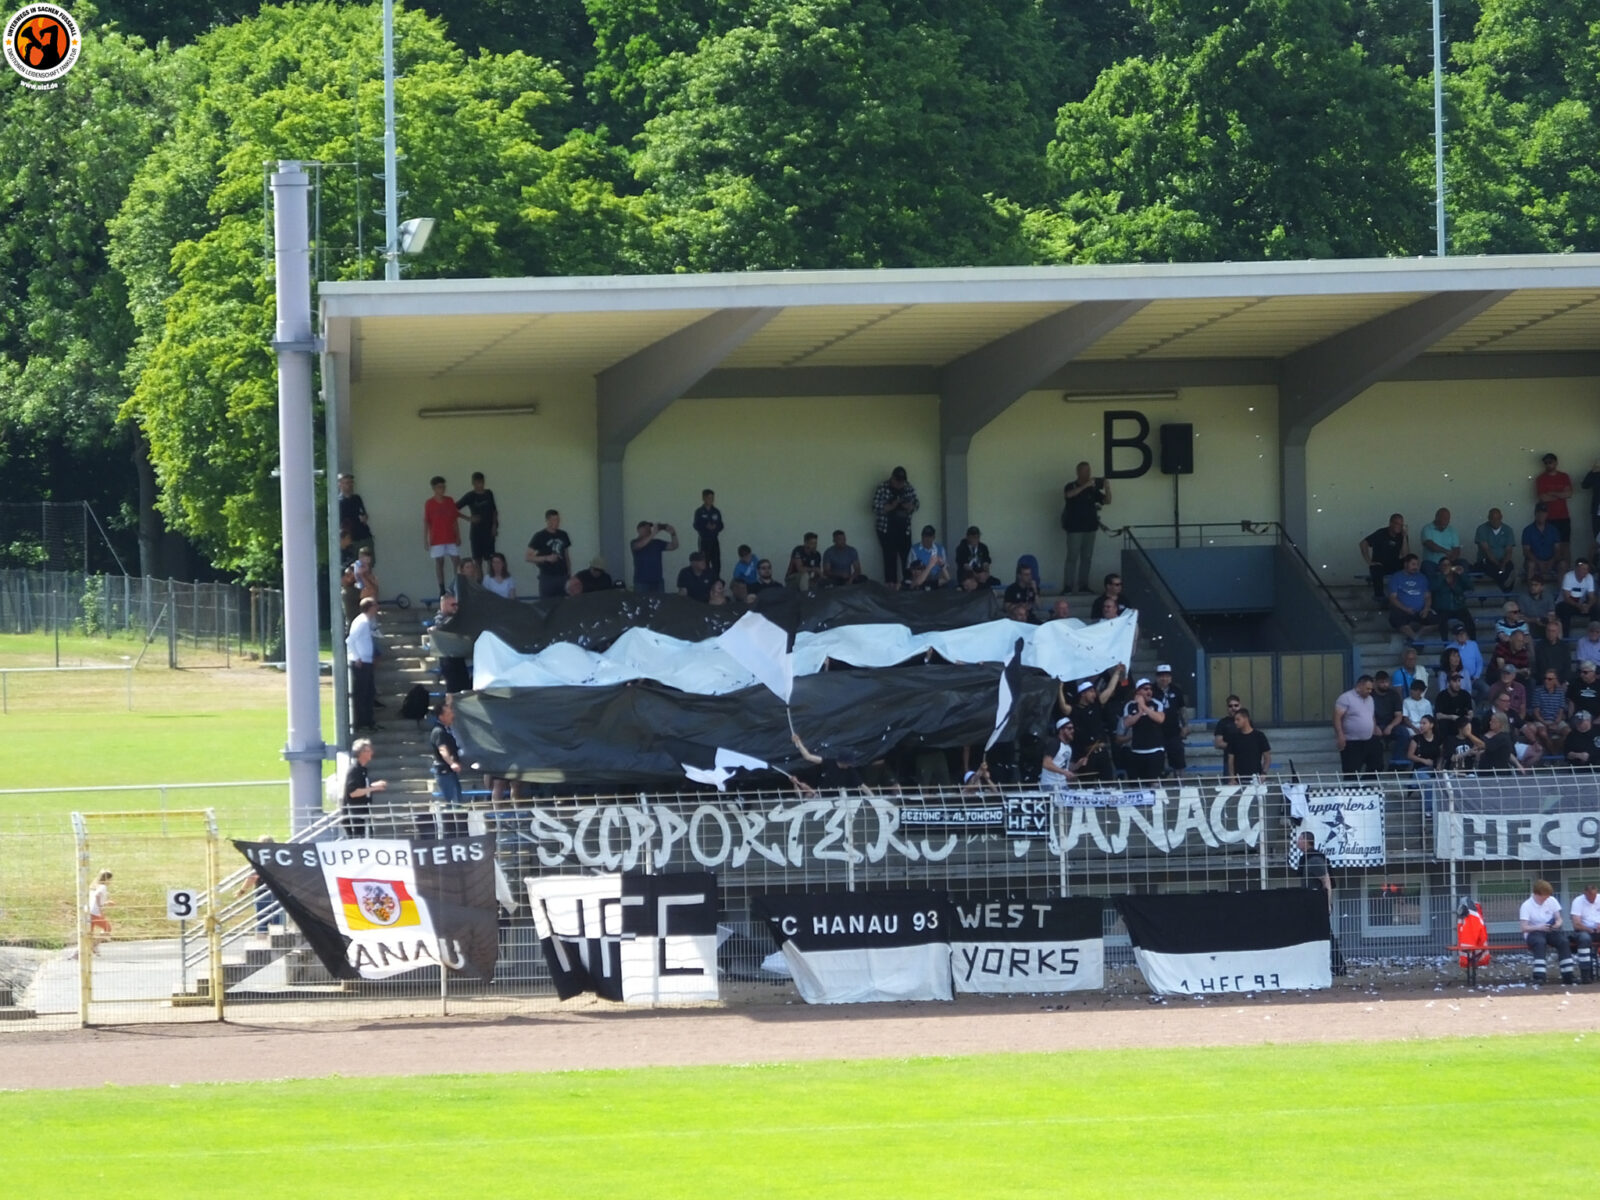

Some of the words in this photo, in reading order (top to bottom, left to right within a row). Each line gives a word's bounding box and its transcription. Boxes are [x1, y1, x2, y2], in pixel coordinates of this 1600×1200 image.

[1104, 410, 1153, 479] B
[1008, 799, 1045, 814] FCK
[1308, 798, 1377, 815] upporters
[1008, 815, 1046, 830] HFV
[1463, 817, 1562, 856] HFC
[303, 842, 485, 867] SUPPORTERS
[812, 915, 899, 935] HANAU
[912, 910, 939, 931] 93
[956, 903, 1052, 929] WEST
[962, 946, 1080, 982] YORKS
